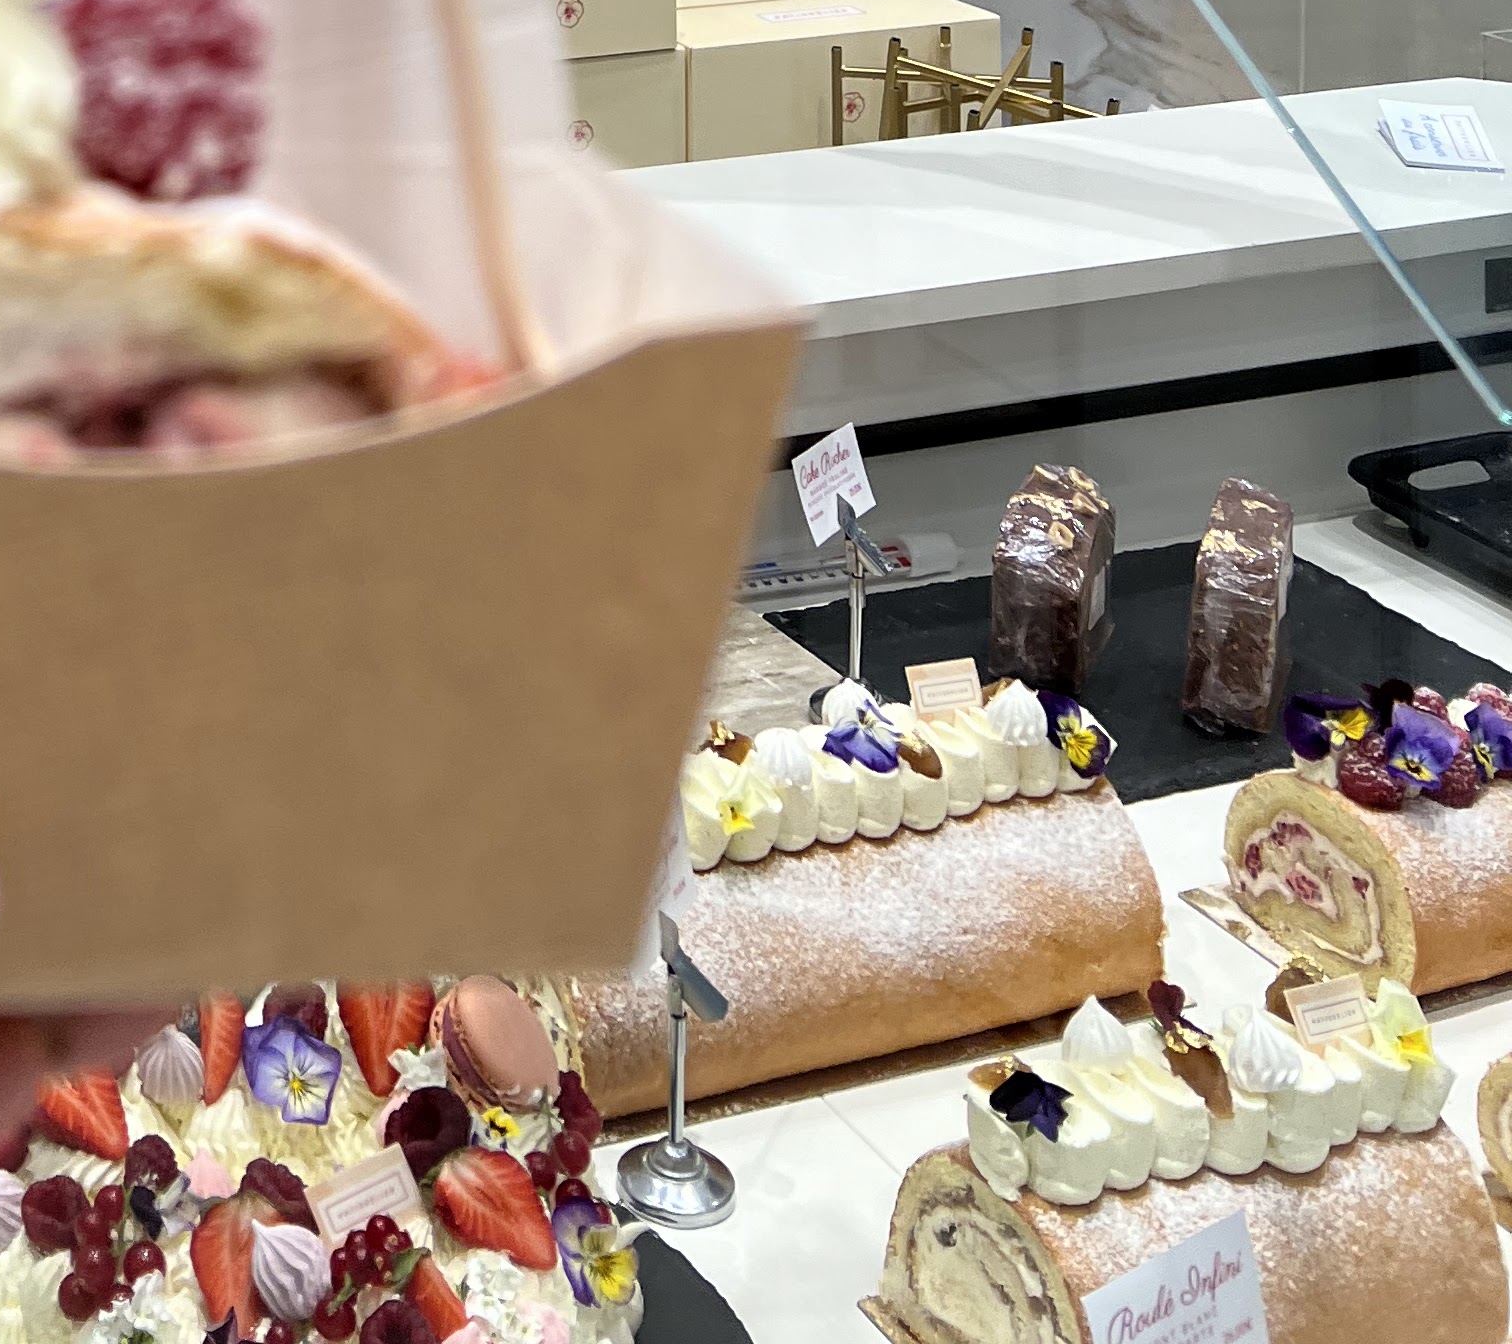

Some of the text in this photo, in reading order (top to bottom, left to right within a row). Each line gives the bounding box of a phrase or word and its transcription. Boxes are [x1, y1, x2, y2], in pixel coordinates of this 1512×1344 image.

[799, 459, 820, 490] Cake
[820, 441, 851, 477] Rocher
[1107, 1284, 1175, 1344] Roulé
[1180, 1251, 1242, 1306] Infini
